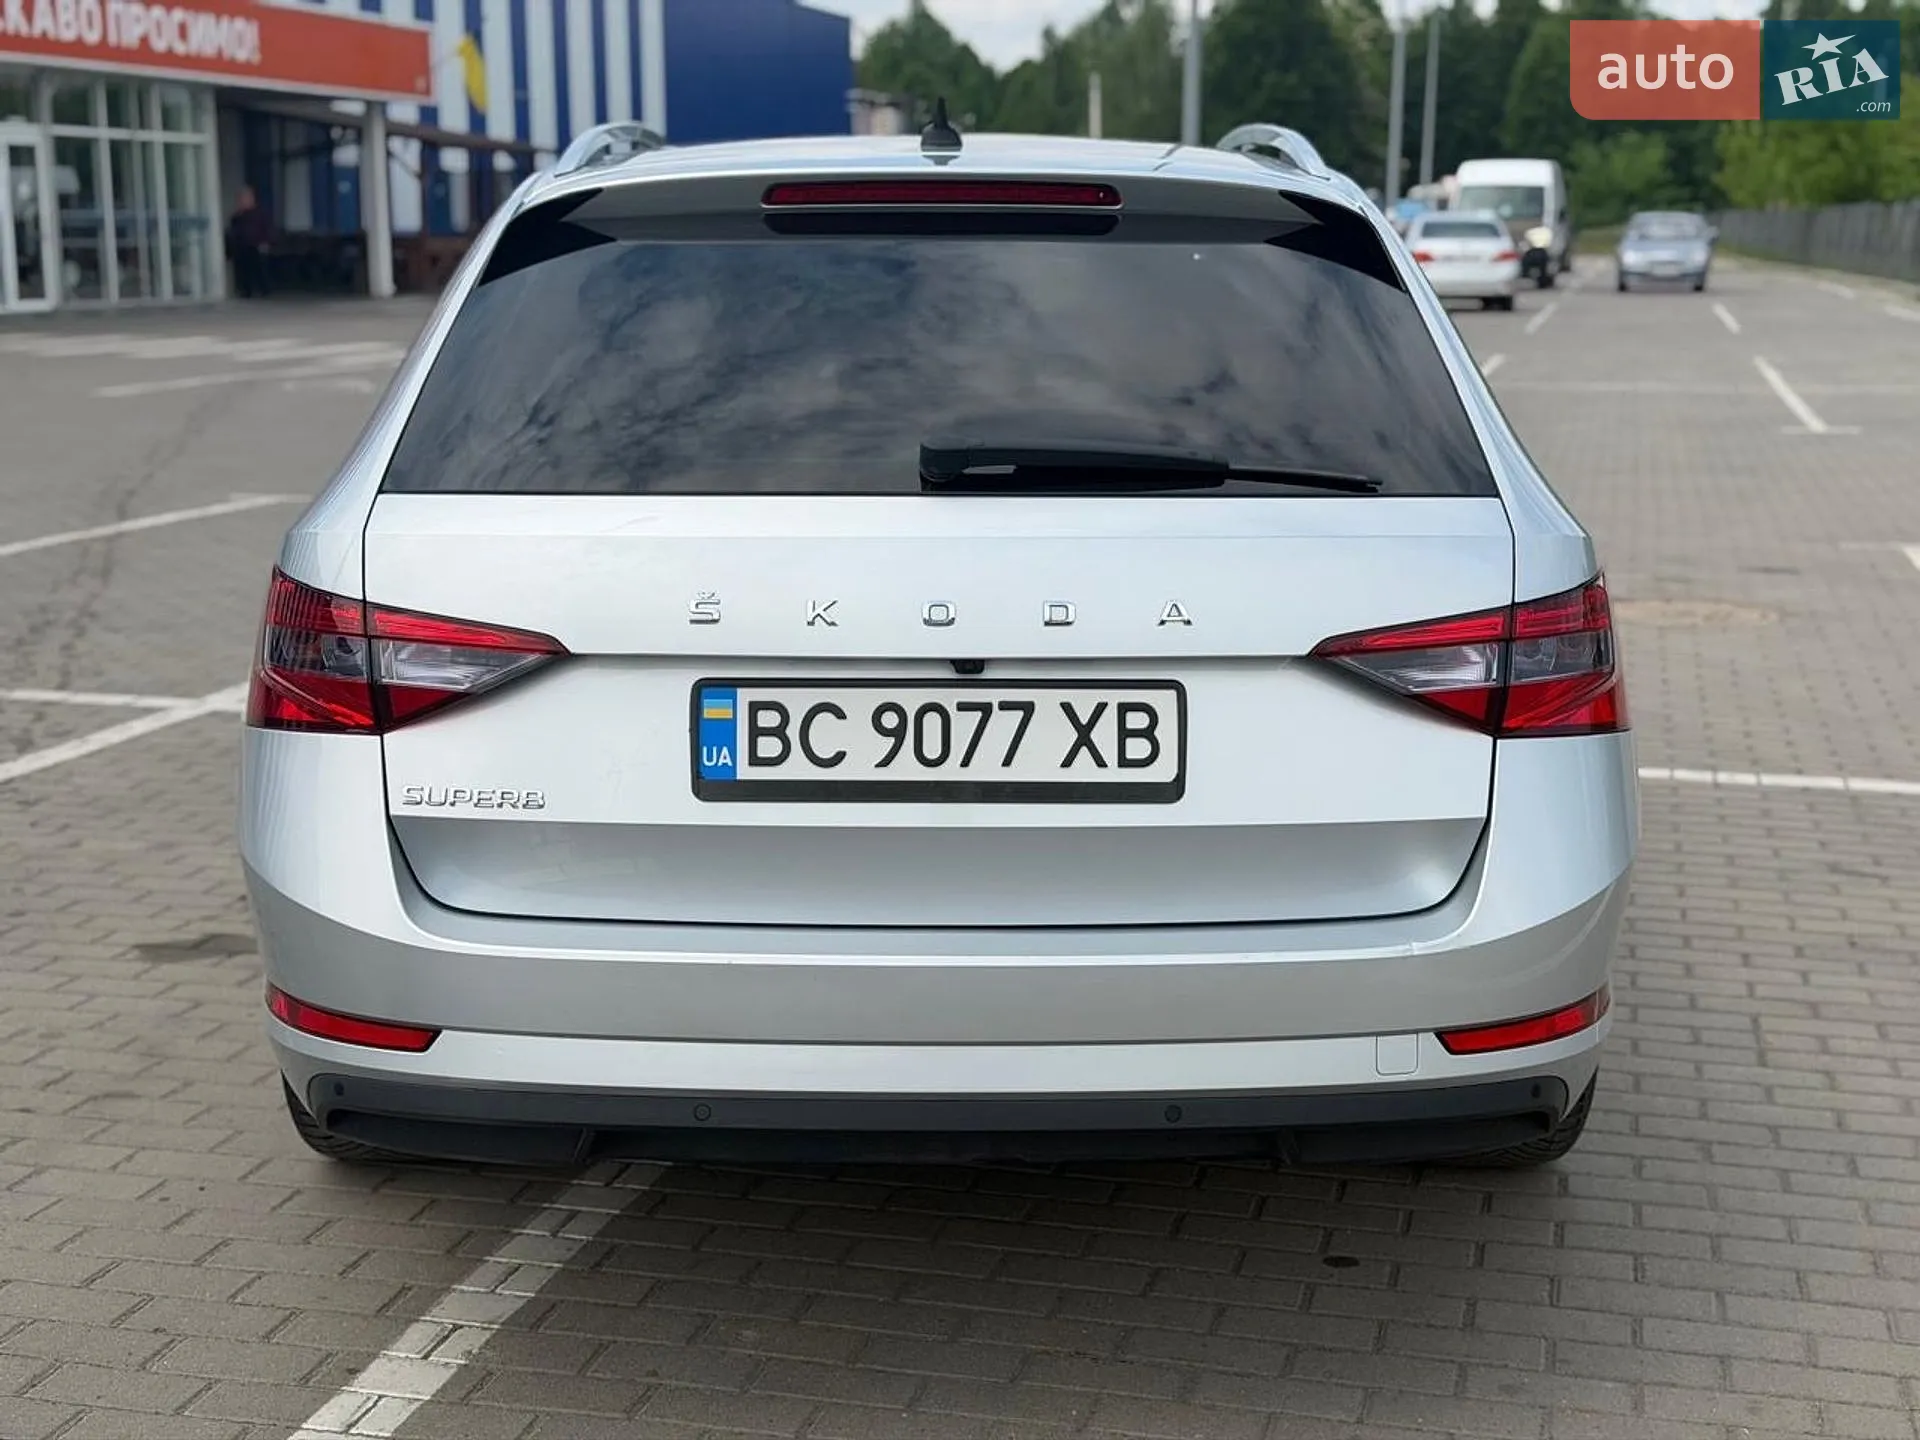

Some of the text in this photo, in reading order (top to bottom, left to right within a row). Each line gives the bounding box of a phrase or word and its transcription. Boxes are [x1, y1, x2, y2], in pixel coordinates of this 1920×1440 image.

[0, 0, 262, 66] КАВО ПРОСИМО!
[688, 591, 1193, 626] ŠKODA
[747, 700, 1161, 768] BC 9077 XB
[702, 746, 732, 767] UA
[402, 785, 546, 809] SUPERB
